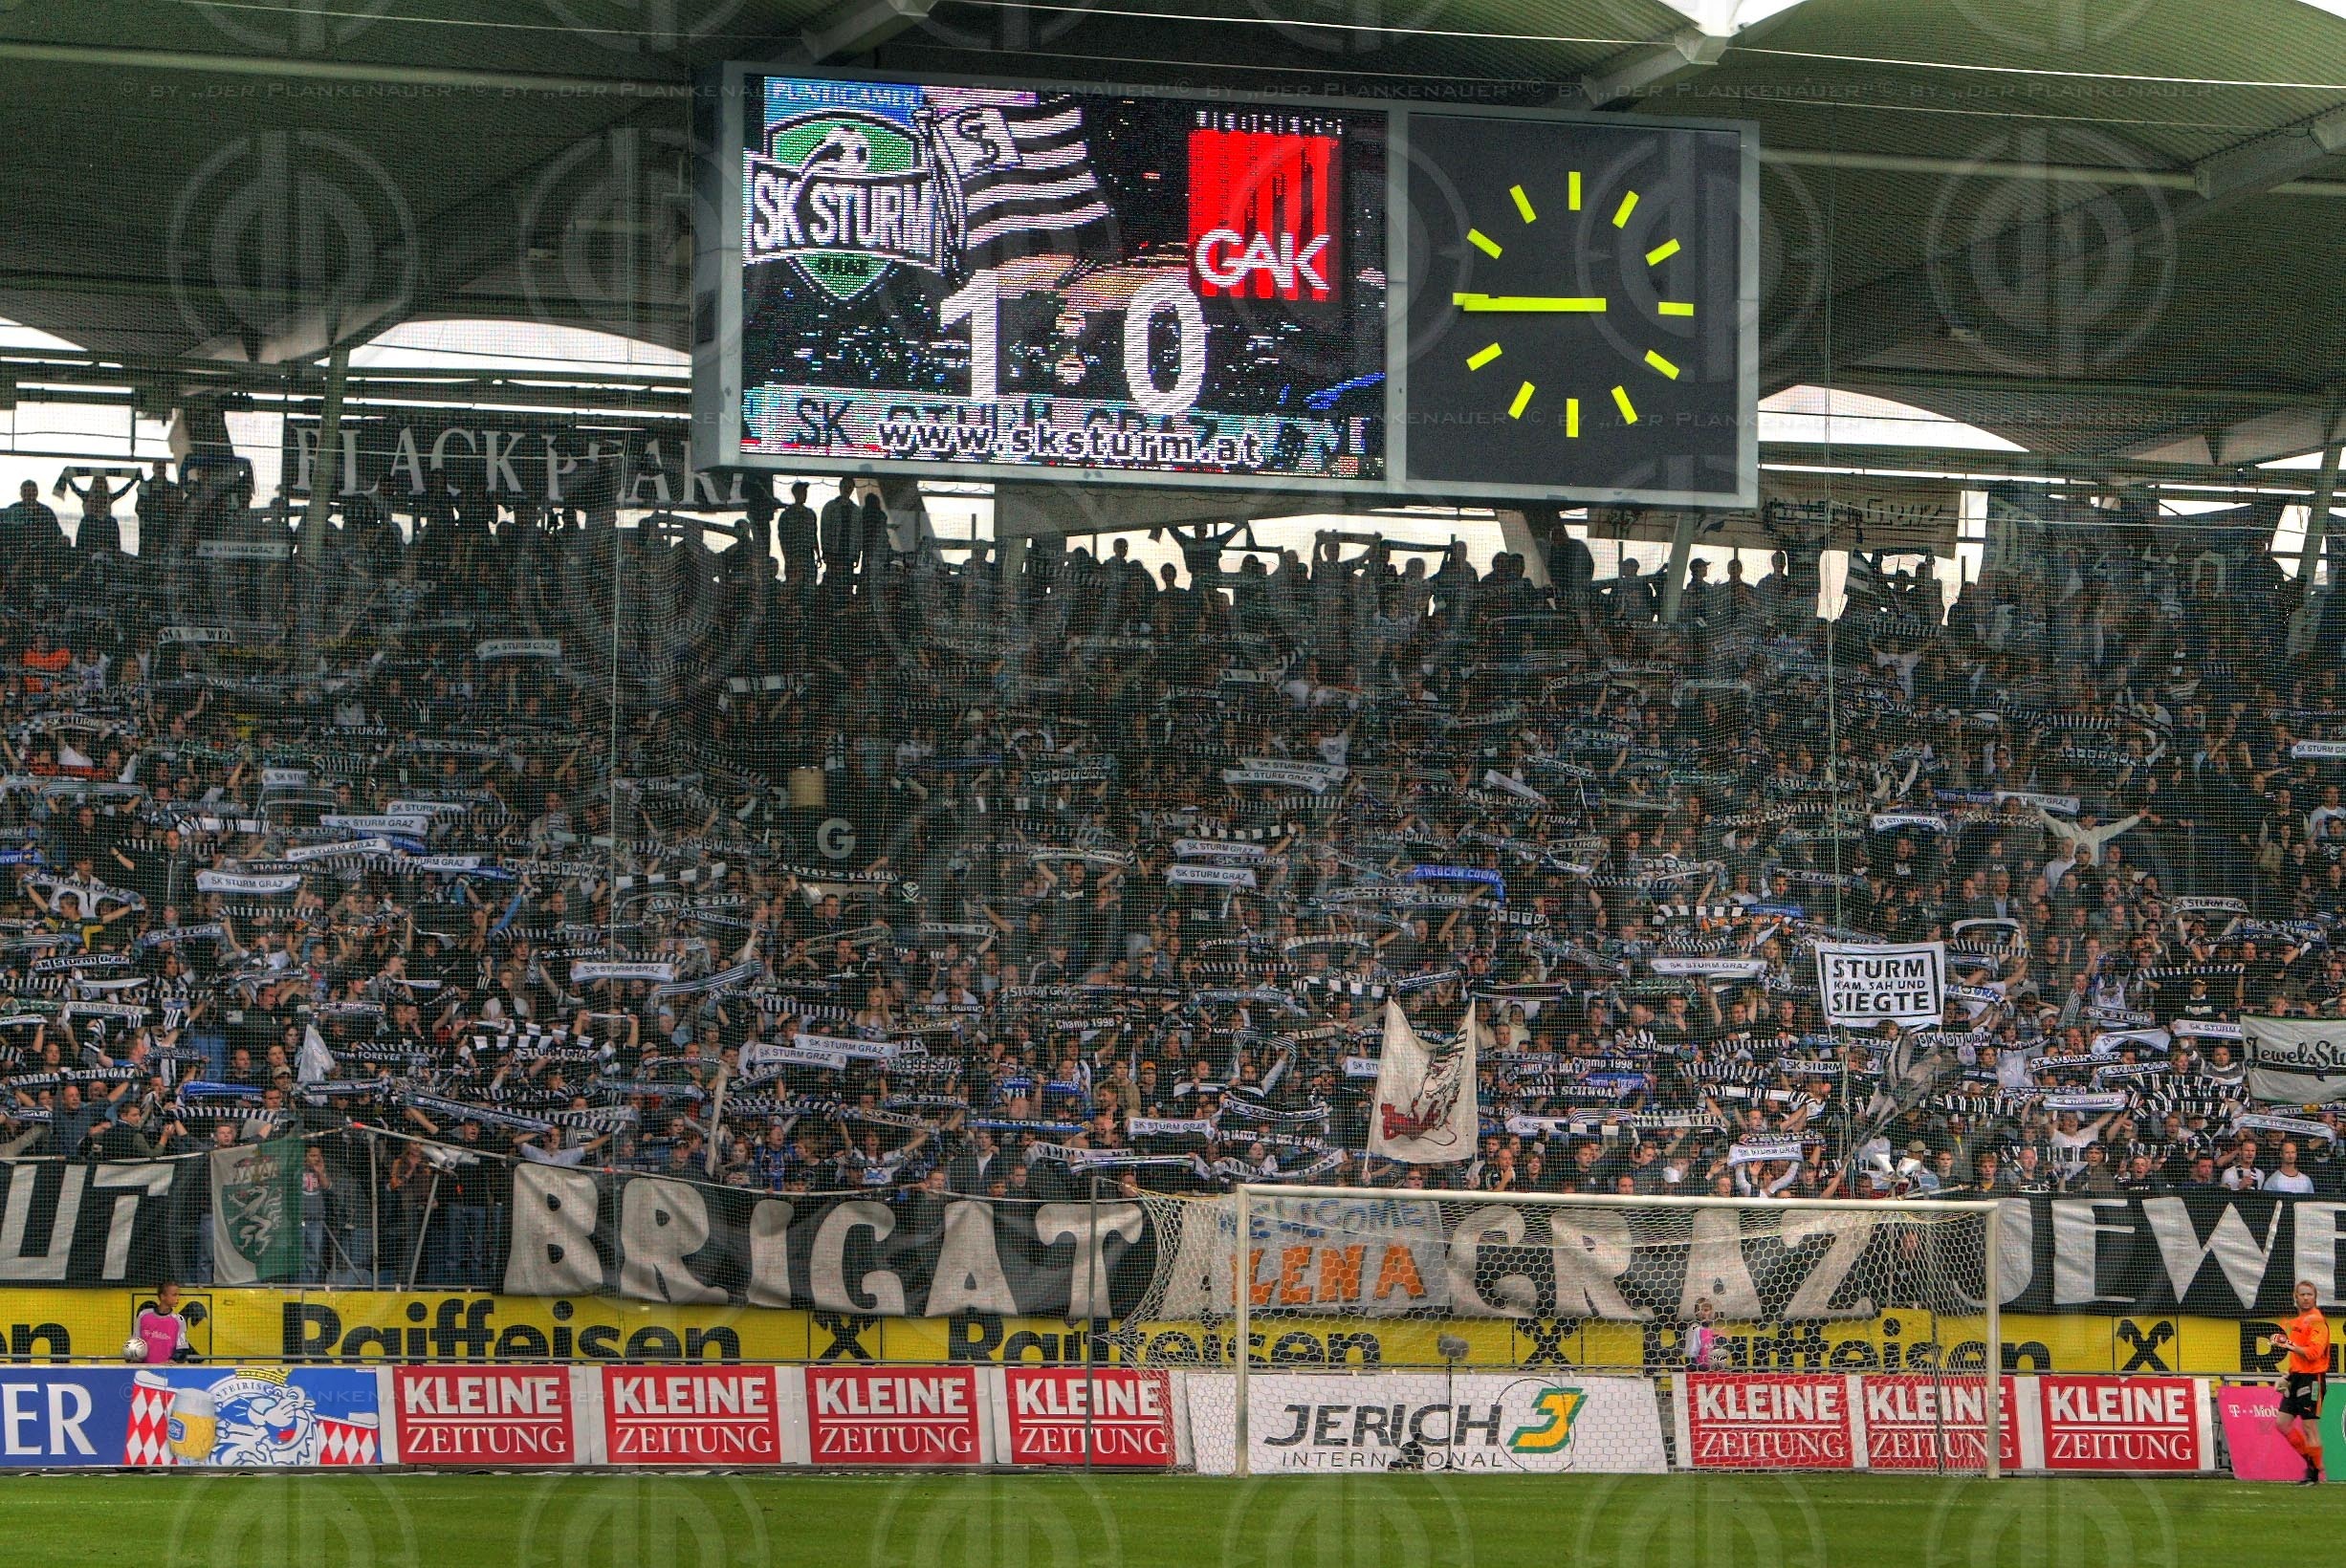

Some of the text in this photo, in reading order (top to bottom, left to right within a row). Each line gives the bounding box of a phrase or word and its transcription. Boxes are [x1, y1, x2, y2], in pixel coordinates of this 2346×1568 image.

[754, 169, 935, 257] SK STURM
[1195, 229, 1331, 291] GAK
[941, 269, 1207, 415] 1 0
[876, 421, 1264, 468] www.sksturm.at
[2308, 744, 2335, 754] STURM
[353, 818, 385, 829] STURM
[388, 819, 415, 829] GRAZ
[816, 817, 857, 860] G
[1200, 842, 1229, 852] STURM
[211, 876, 284, 888] SK STURM GRAZ
[1190, 869, 1219, 880] STURM
[2187, 900, 2224, 909] STURM
[174, 926, 222, 941] STURM
[561, 947, 606, 957] STURM
[1721, 961, 1749, 970] GRAZ
[1832, 959, 1925, 978] STURM
[1833, 980, 1926, 991] KAM, SAH UND
[85, 1004, 113, 1014] STURM
[115, 1006, 138, 1015] GRAZ
[1832, 991, 1930, 1013] SIEGTE
[1056, 1017, 1115, 1031] Champ 1998
[773, 1049, 805, 1060] STURM
[807, 1052, 832, 1061] GRAZ
[823, 1039, 855, 1051] STURM
[858, 1043, 885, 1055] GRAZ
[1354, 1060, 1365, 1070] SK
[1612, 1058, 1633, 1070] 1998
[1787, 1061, 1844, 1073] SK STURM
[10, 1066, 136, 1087] SAMMA SCHWOAZ
[1148, 1121, 1181, 1131] STURM
[1446, 1199, 1876, 1322] GRAZ
[282, 1298, 742, 1365] Raiffeisen
[403, 1376, 562, 1415] KLEINE
[612, 1376, 771, 1415] KLEINE
[815, 1376, 969, 1415] KLEINE
[1016, 1378, 1163, 1415] KLEINE
[1696, 1383, 1842, 1423] KLEINE
[2049, 1384, 2190, 1424] KLEINE
[2, 1383, 98, 1456] ER
[1262, 1404, 1504, 1448] JERICH
[406, 1426, 567, 1456] ZEITUNG
[615, 1426, 774, 1456] ZEITUNG
[818, 1426, 973, 1456] ZEITUNG
[1019, 1426, 1169, 1456] ZEITUNG
[1698, 1430, 1846, 1461] ZEITUNG
[2050, 1433, 2193, 1462] ZEITUNG
[1282, 1450, 1504, 1469] INTERNONAL
